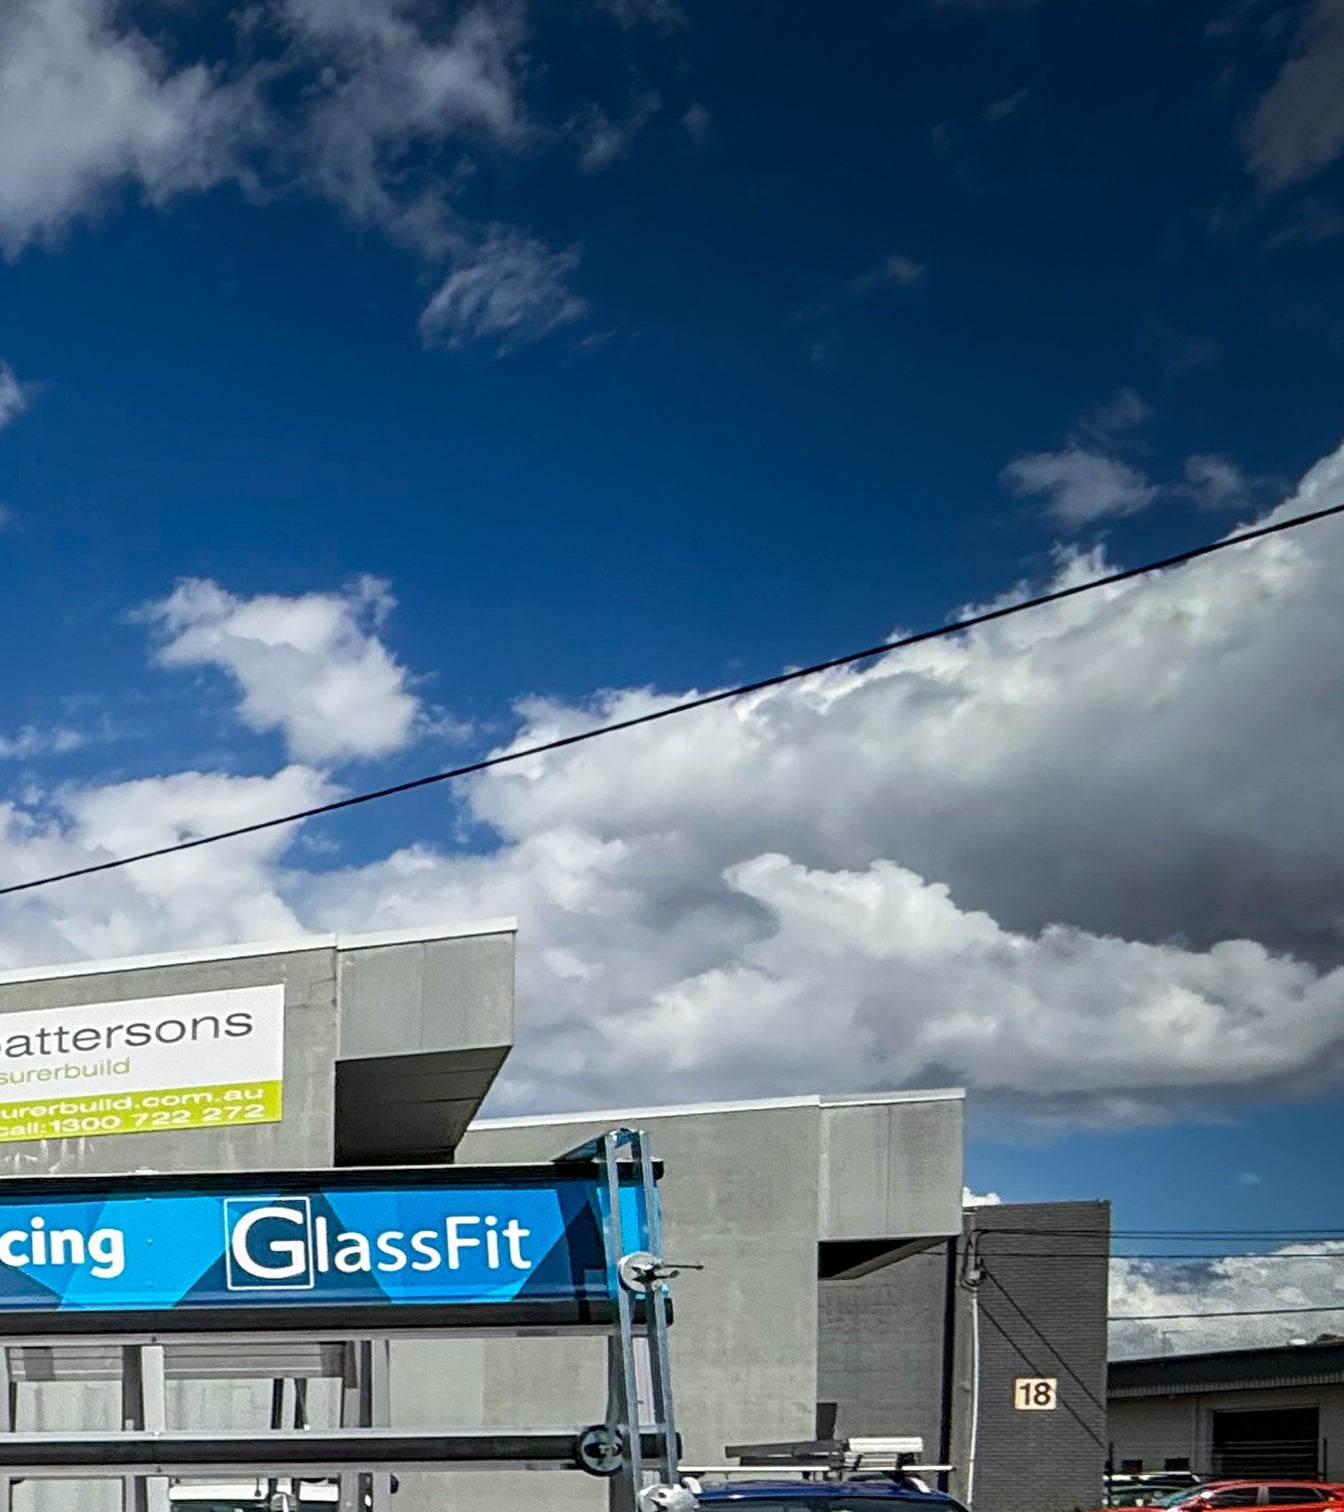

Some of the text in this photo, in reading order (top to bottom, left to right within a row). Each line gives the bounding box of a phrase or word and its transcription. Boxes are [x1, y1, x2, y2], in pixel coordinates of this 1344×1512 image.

[132, 1109, 191, 1128] 722
[202, 1103, 266, 1121] 272
[231, 1206, 532, 1278] GlassFit
[1018, 1383, 1052, 1406] 18
